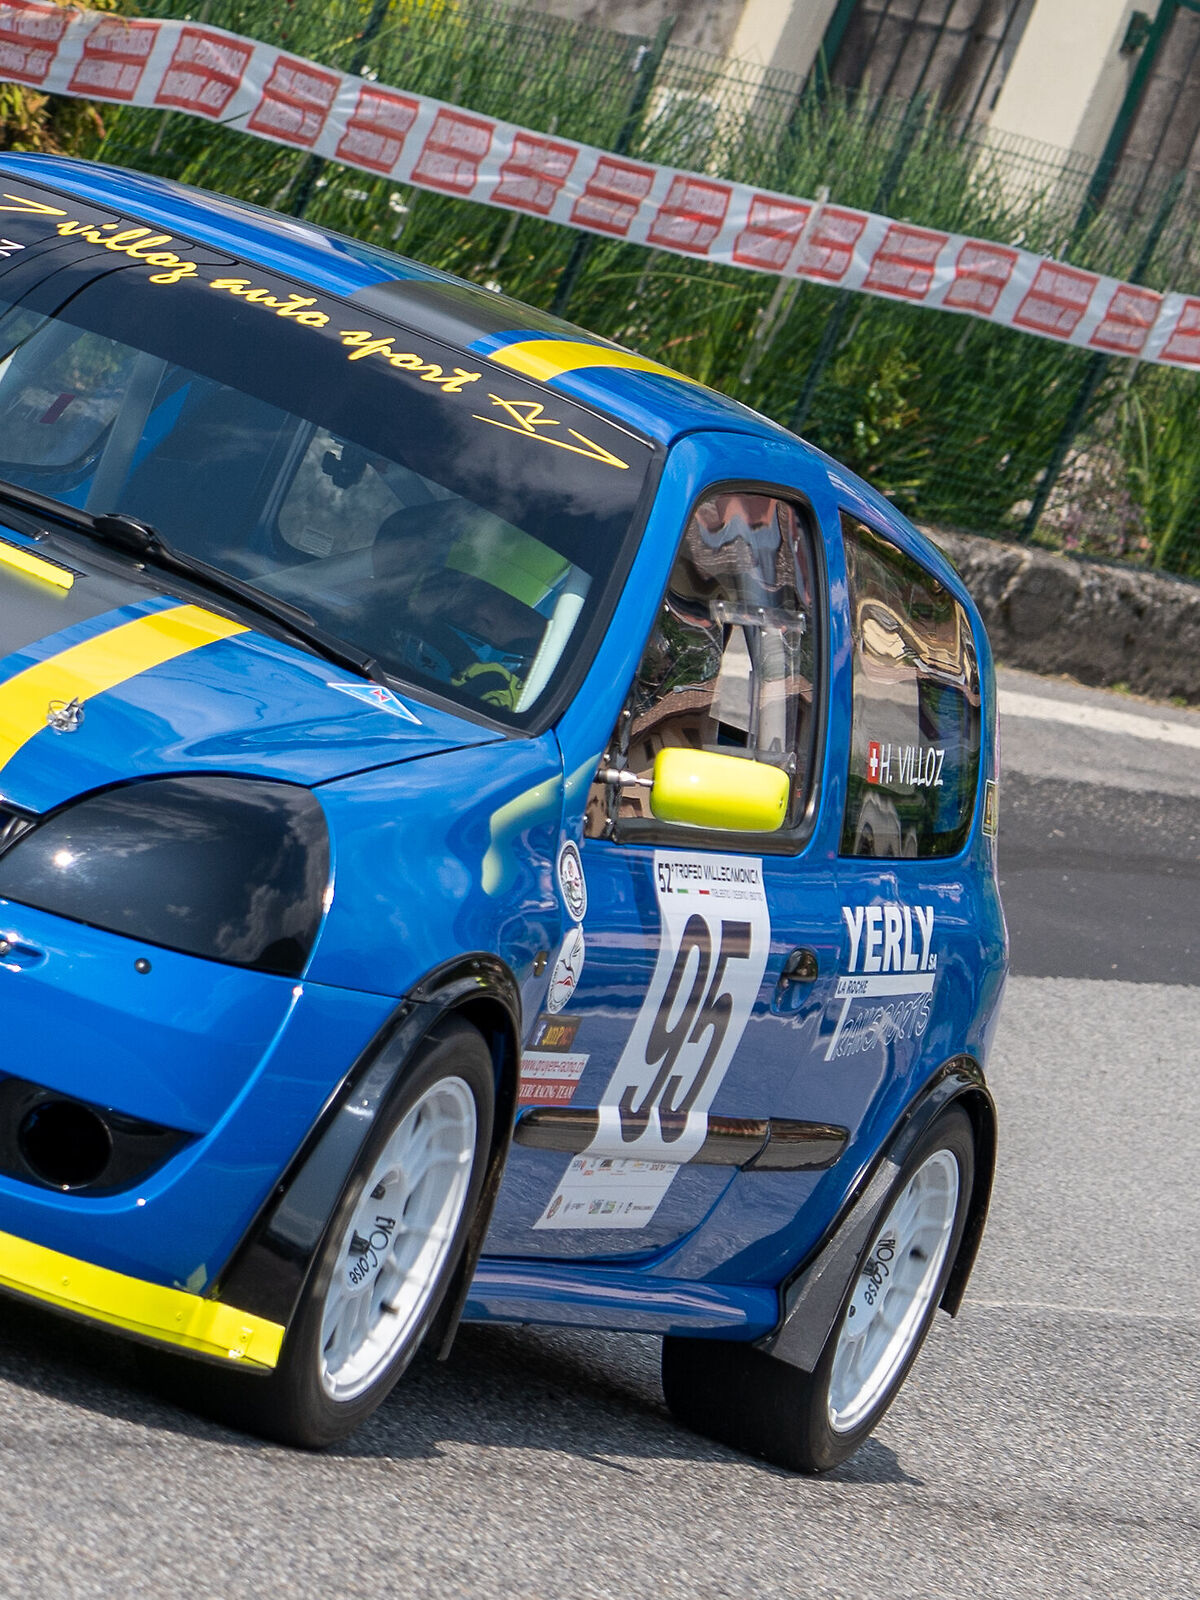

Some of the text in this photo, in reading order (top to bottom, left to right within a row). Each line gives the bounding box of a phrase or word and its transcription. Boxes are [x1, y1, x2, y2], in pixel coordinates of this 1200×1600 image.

[56, 218, 482, 393] villoz auto sport
[880, 744, 946, 787] H. VILLOZ
[674, 863, 703, 880] TROFEO
[703, 865, 761, 885] VALLECAMONICA
[842, 905, 935, 974] YERLY
[836, 979, 869, 995] LA ROCHE
[618, 913, 753, 1144] 95
